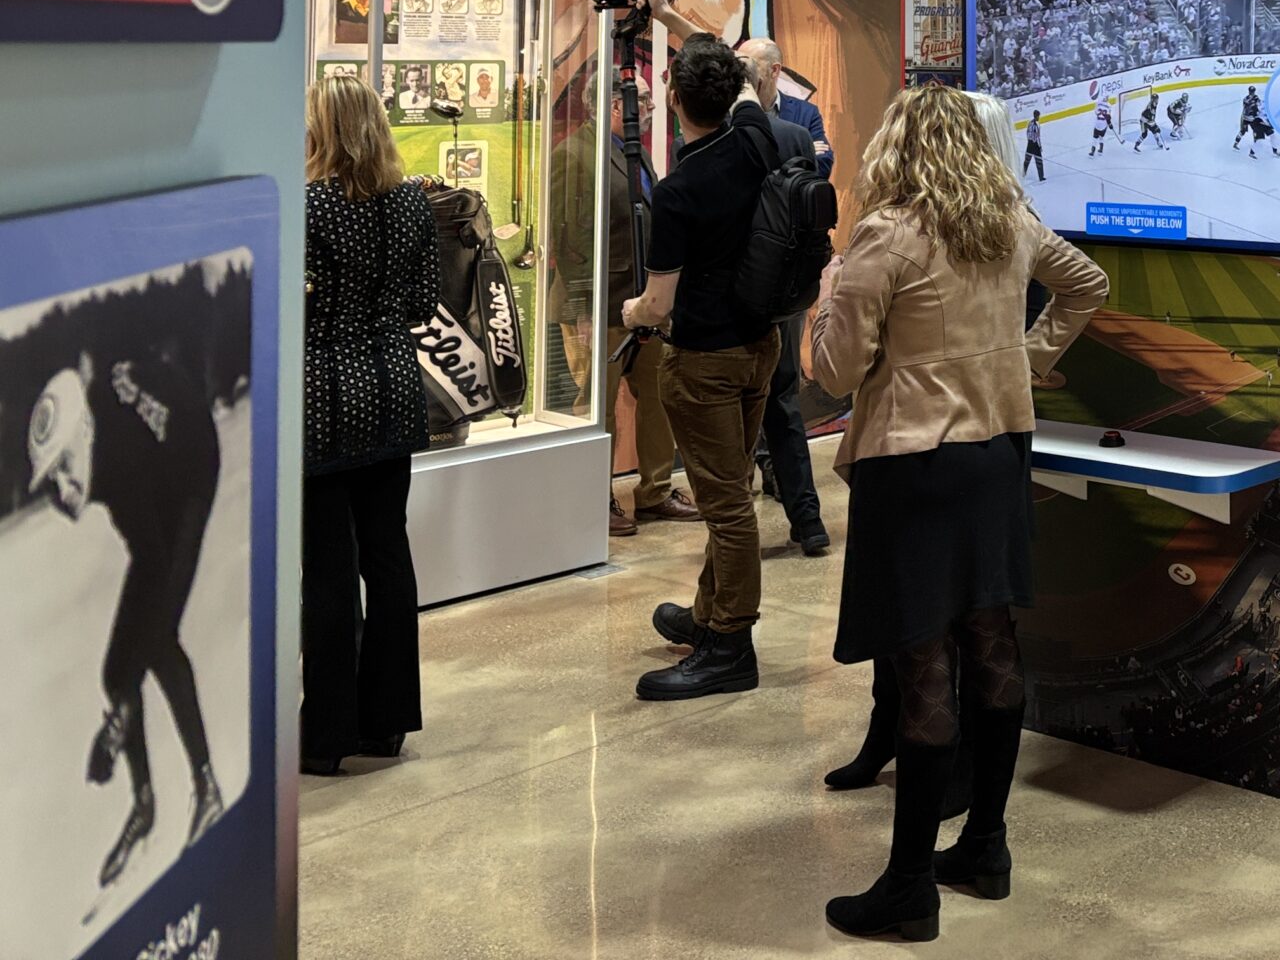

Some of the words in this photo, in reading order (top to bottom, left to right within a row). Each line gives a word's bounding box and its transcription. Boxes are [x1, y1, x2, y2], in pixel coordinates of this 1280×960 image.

[1228, 57, 1277, 70] NovaCare
[1143, 69, 1173, 84] KeyBank
[1101, 80, 1124, 96] pepsi
[1090, 215, 1110, 225] PUSH
[1111, 216, 1125, 226] THE
[1126, 217, 1155, 228] BUTTON
[1156, 218, 1183, 229] BELOW
[487, 281, 521, 368] Titleist
[418, 309, 490, 408] tleist
